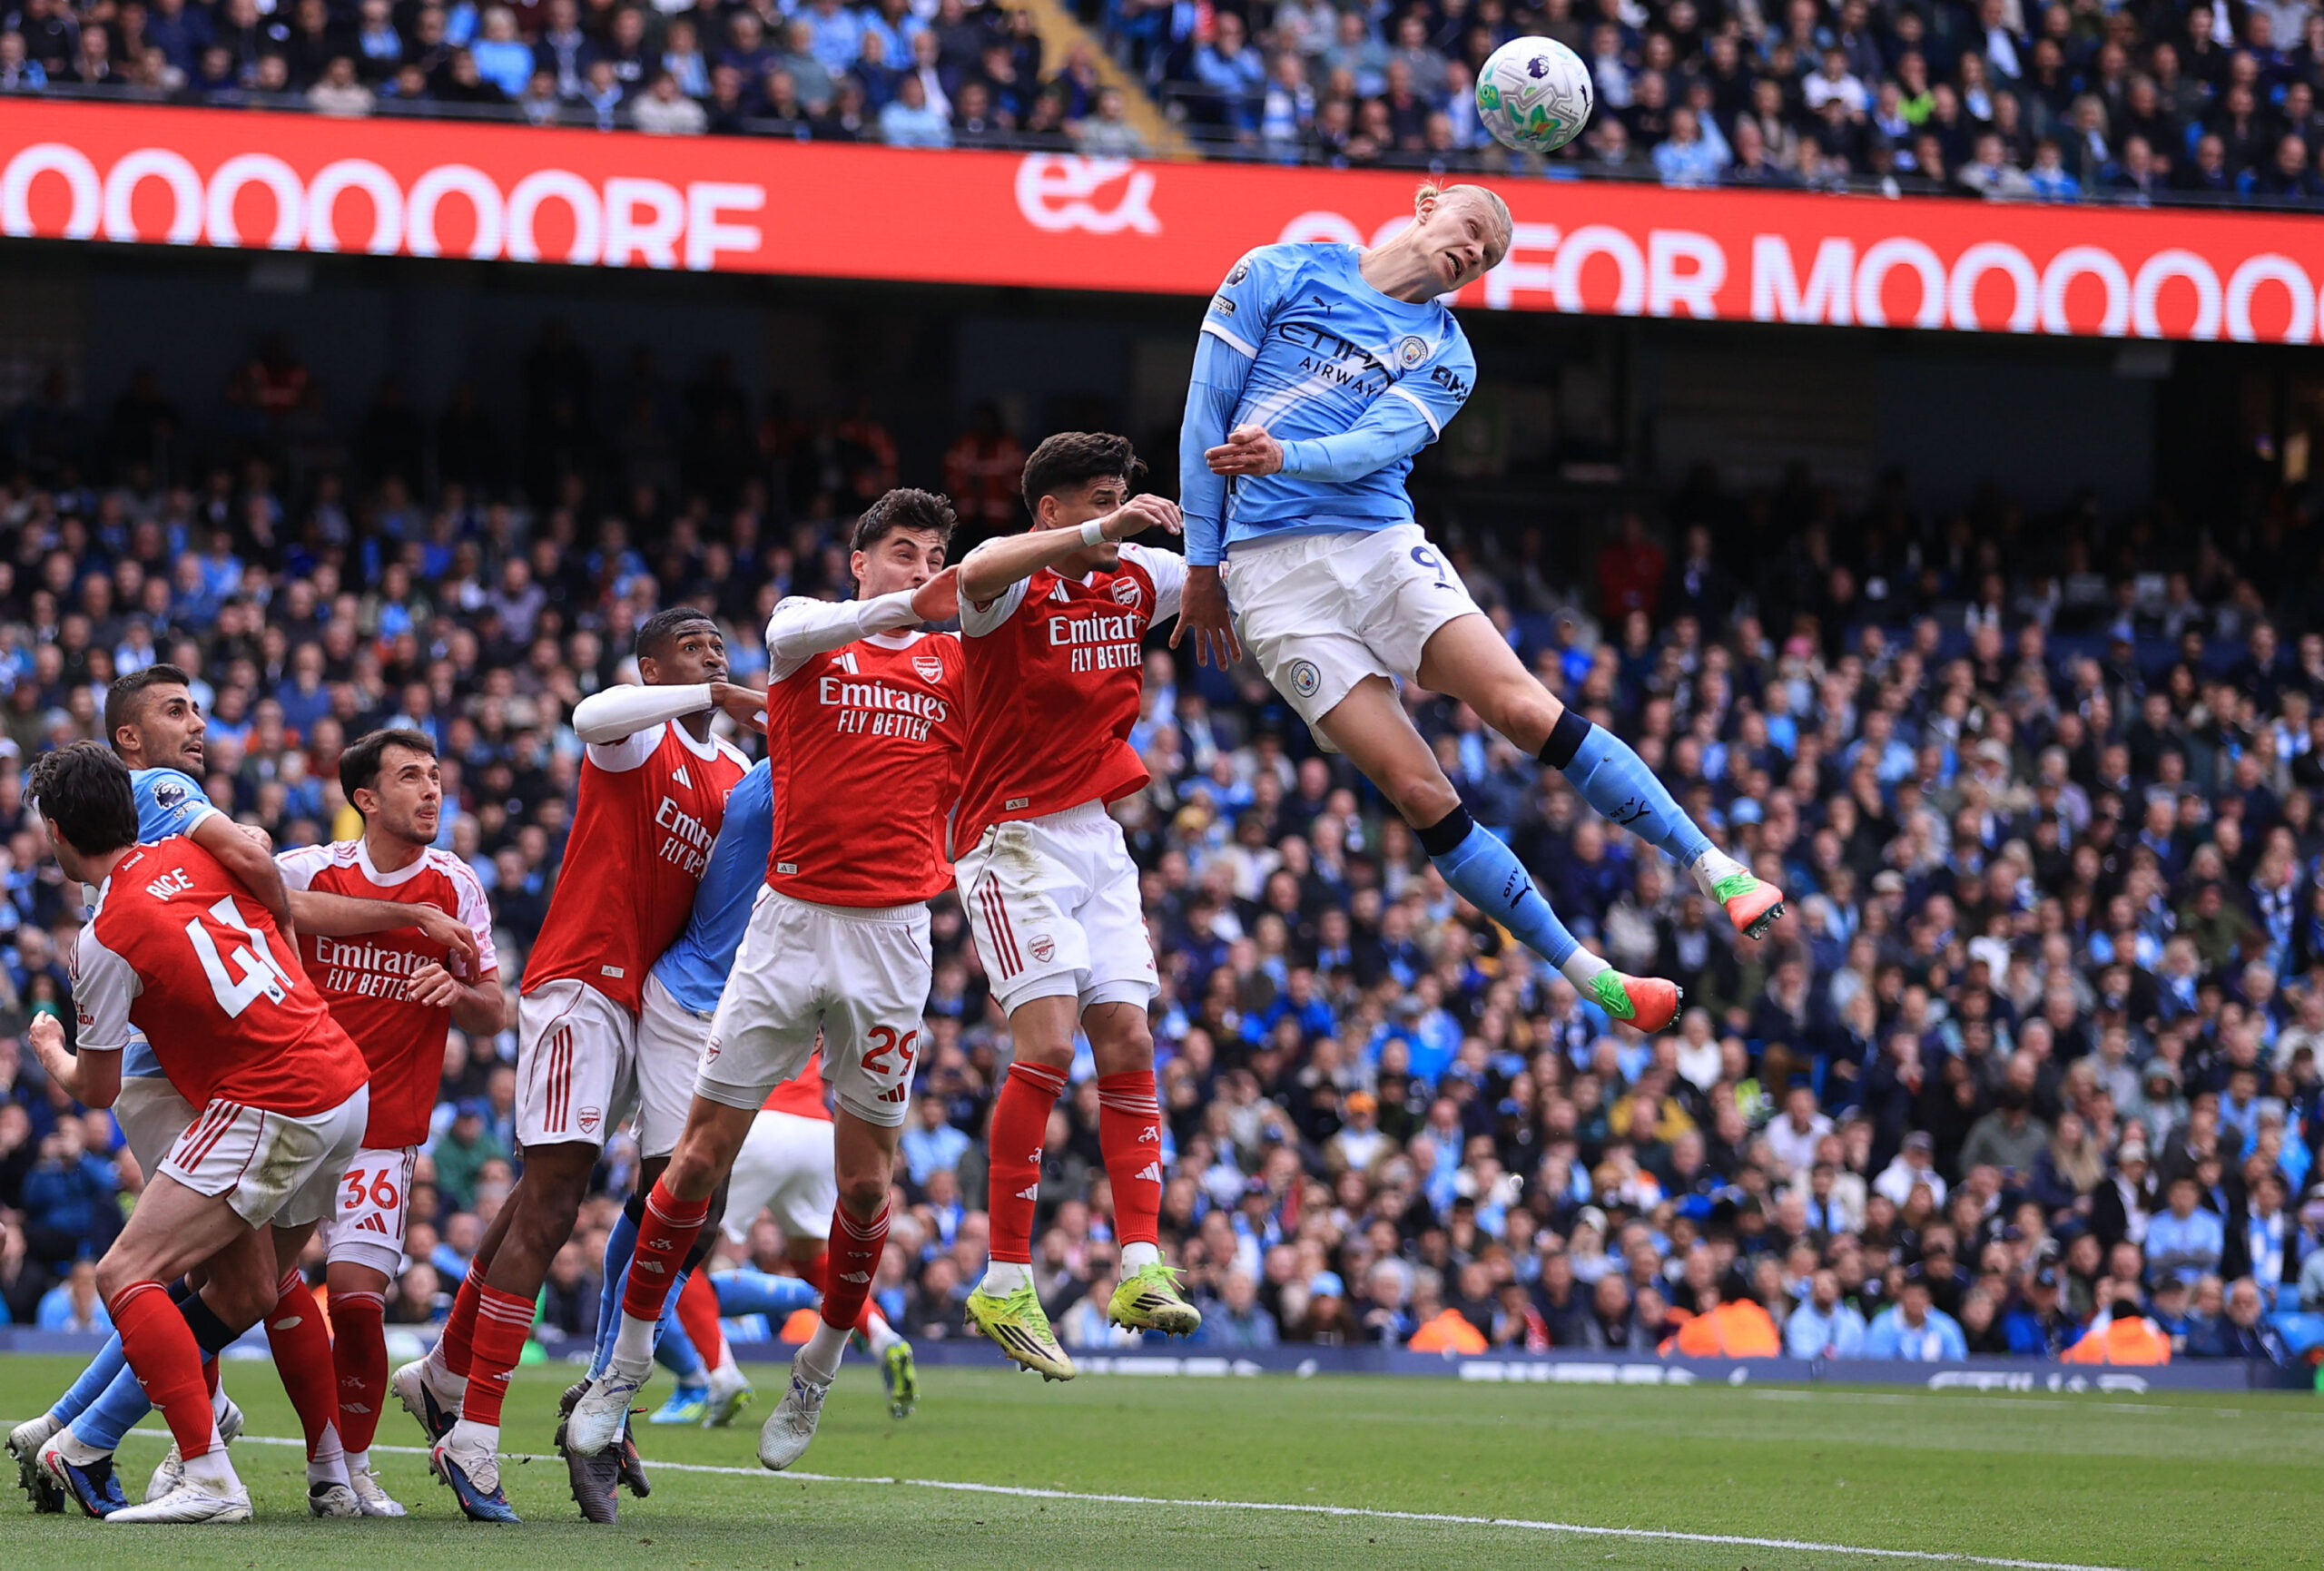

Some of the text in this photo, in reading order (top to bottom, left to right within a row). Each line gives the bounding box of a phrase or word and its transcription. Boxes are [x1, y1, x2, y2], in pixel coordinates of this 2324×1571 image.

[1751, 231, 2324, 346] MOOOOO
[1298, 356, 1382, 398] AIRWAY
[1410, 546, 1446, 581] 9
[1049, 611, 1147, 646] Emirat
[1071, 647, 1092, 673] FLY
[819, 676, 949, 723] Emirates
[837, 710, 932, 741] FLY BETTER
[659, 836, 688, 865] FLY
[145, 867, 195, 901] RICE
[184, 893, 295, 1019] 41
[326, 968, 356, 992] FLY
[861, 1026, 918, 1077] 29
[341, 1169, 399, 1210] 36
